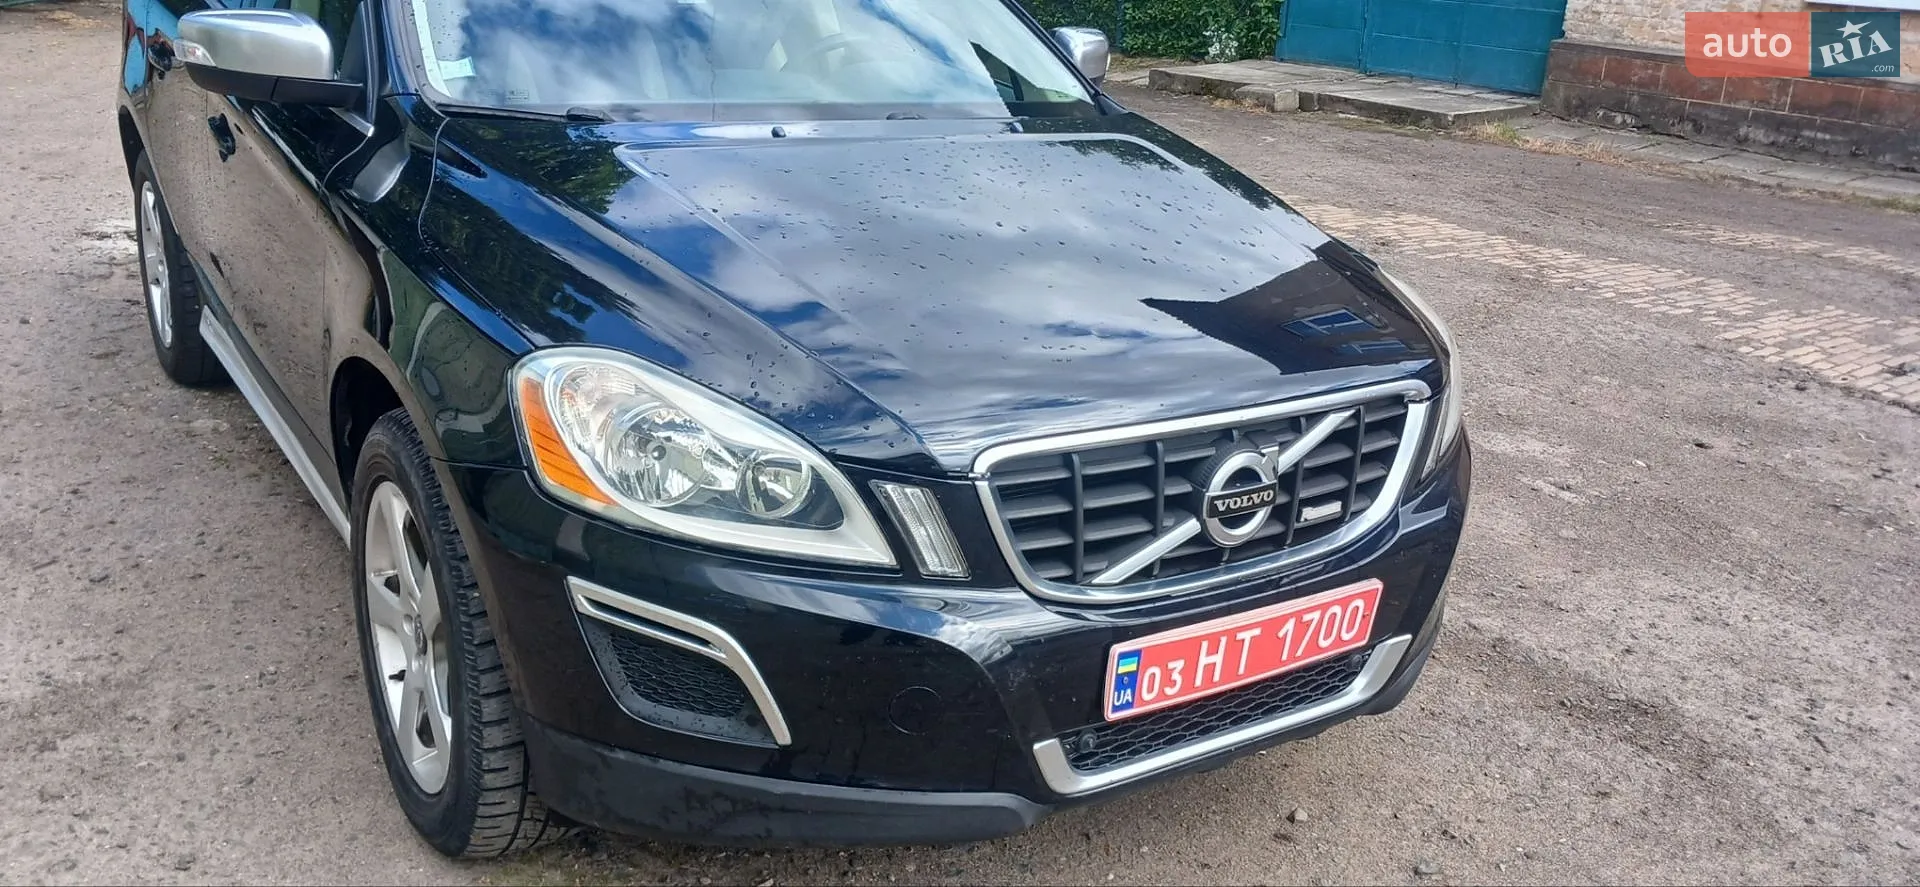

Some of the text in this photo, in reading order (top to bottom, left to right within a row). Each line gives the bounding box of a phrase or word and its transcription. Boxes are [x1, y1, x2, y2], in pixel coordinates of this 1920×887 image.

[1213, 489, 1275, 513] VOLVO
[1140, 598, 1366, 701] 03 HT 1700
[1113, 690, 1133, 707] UA
